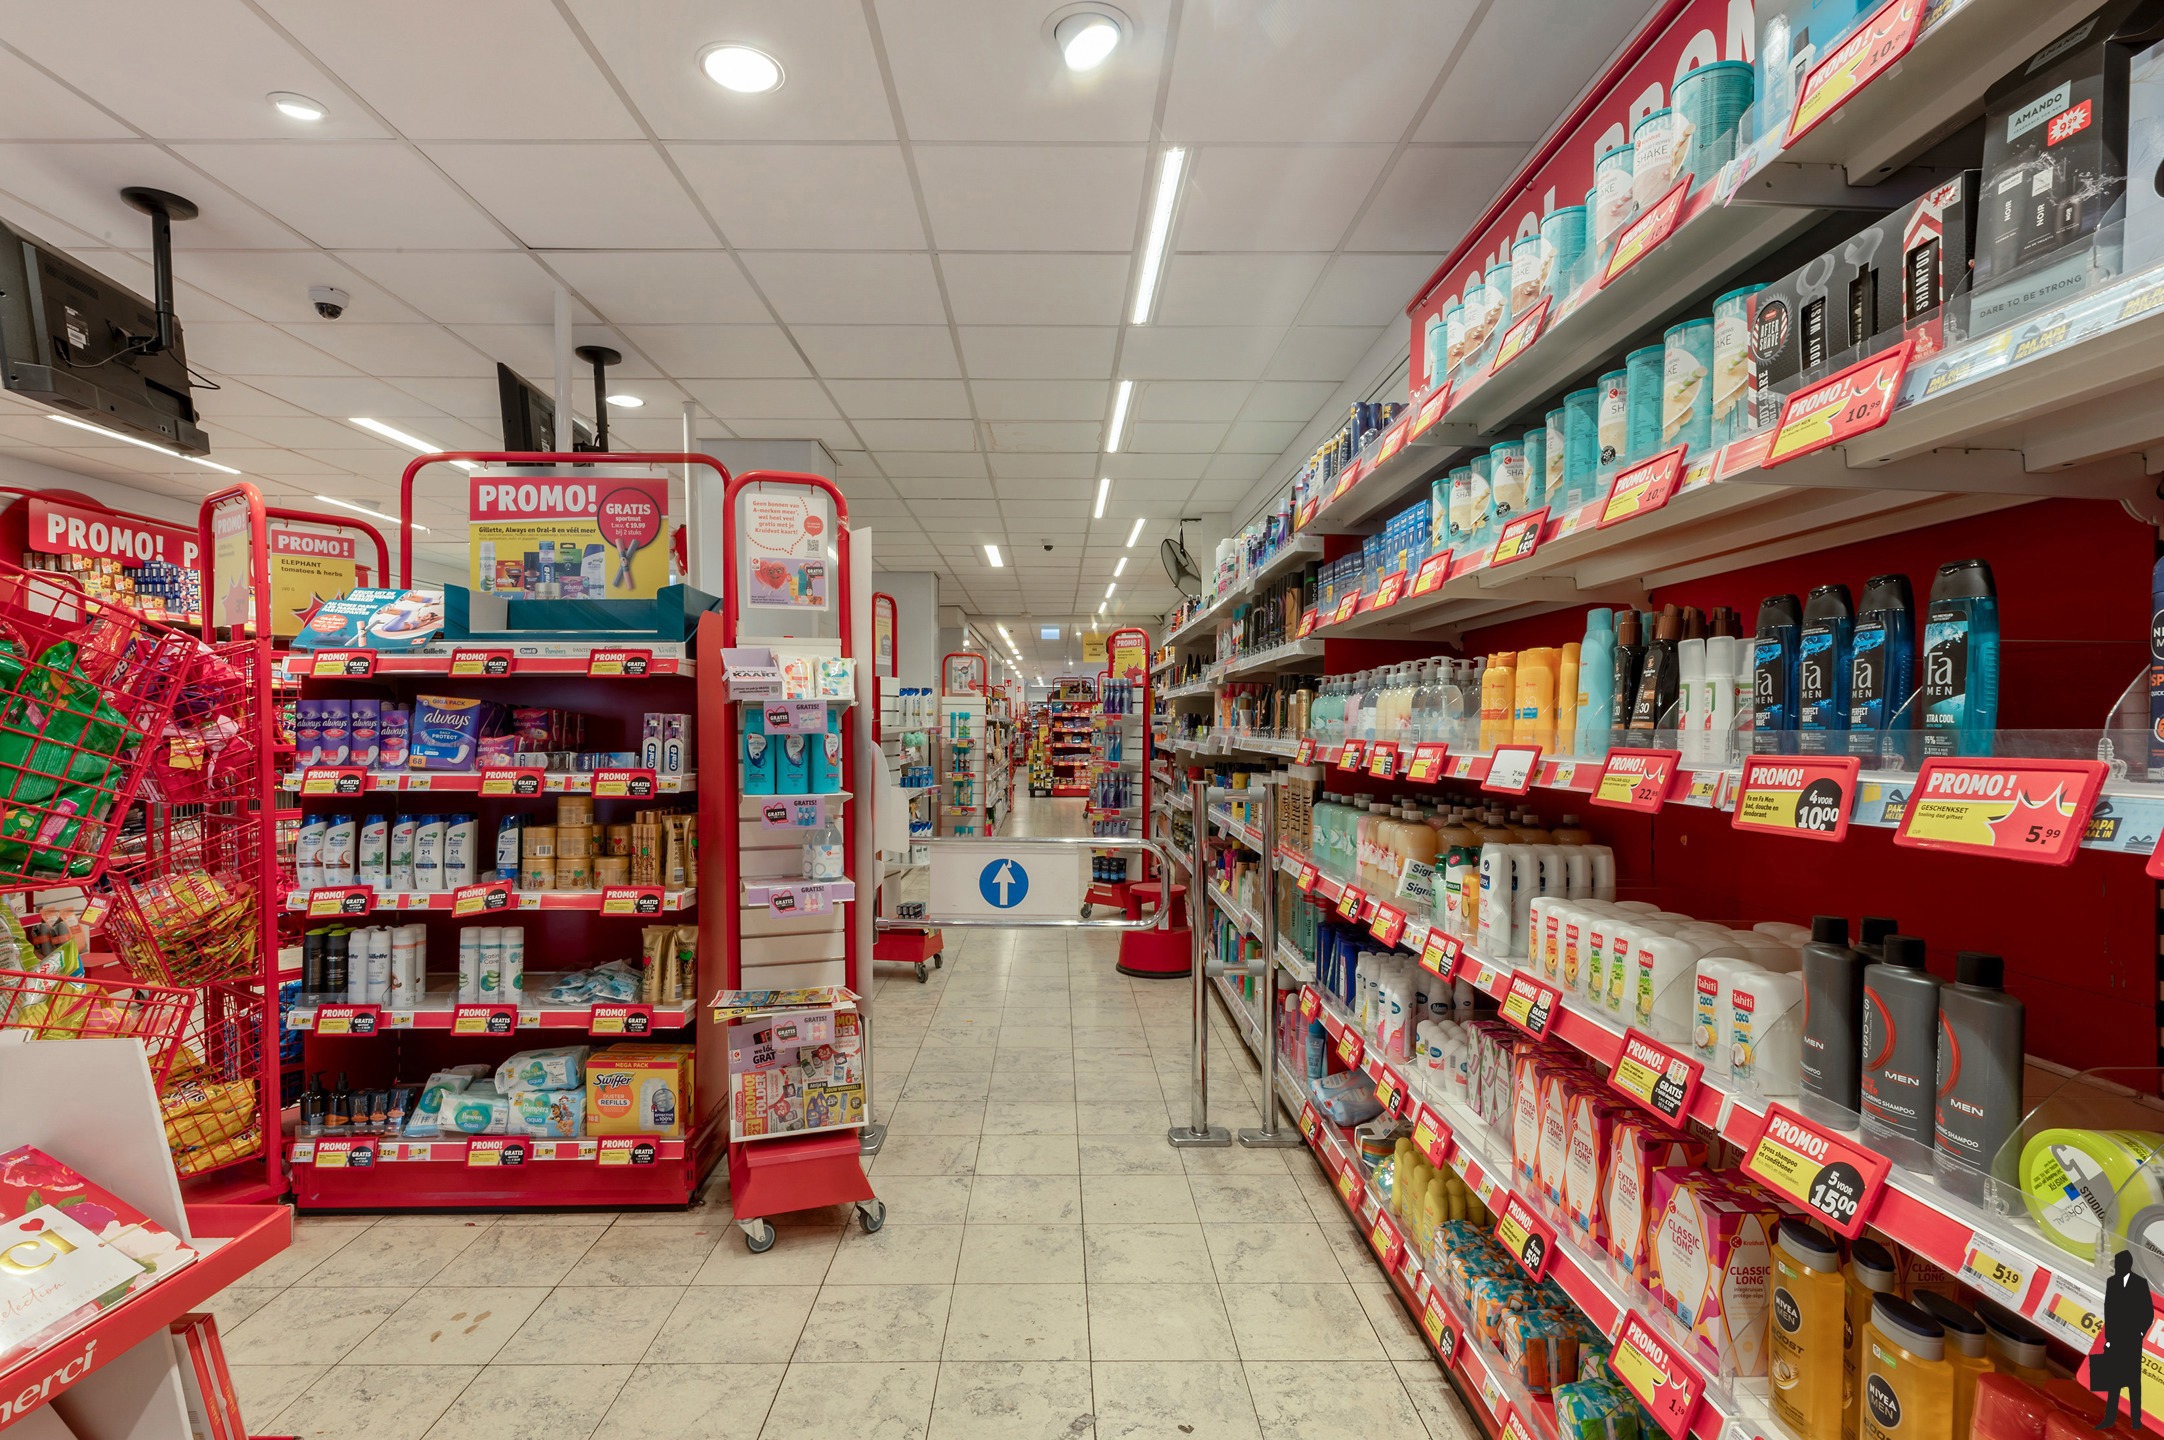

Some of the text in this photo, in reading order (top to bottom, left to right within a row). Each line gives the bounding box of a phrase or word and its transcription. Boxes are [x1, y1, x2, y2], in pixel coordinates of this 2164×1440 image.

[1805, 25, 1875, 96] PROMO!
[2014, 93, 2063, 126] AMANDO
[2004, 199, 2012, 222] NOIR
[2036, 203, 2045, 227] NOIR
[1916, 249, 1930, 312] SHAMPOO
[1980, 274, 2082, 318] DARE TO BE STRONG
[1760, 319, 1779, 338] AFTER
[2018, 325, 2067, 353] PAK PAPA
[1786, 378, 1851, 421] PROMO!
[1845, 400, 1881, 423] 10.99
[1615, 466, 1652, 494] PROMO!
[479, 484, 597, 513] PROMO!
[606, 504, 652, 515] GRATIS
[48, 513, 164, 562] PROMO!
[506, 527, 527, 535] Always
[277, 535, 349, 556] PROMO!
[281, 558, 322, 570] ELEPHANT
[281, 566, 343, 578] tomatoes herbs
[545, 648, 572, 656] Pampers
[1116, 639, 1141, 647] PROMO!
[318, 653, 349, 662] PROMO!
[456, 653, 487, 662] PROMO!
[595, 653, 627, 662] PROMO!
[1802, 661, 1822, 690] Fa
[1852, 658, 1873, 689] Fa
[1927, 652, 1953, 686] Fa
[1755, 669, 1773, 695] Fa
[1927, 686, 1953, 696] MEN
[1755, 696, 1774, 705] MEN
[1802, 690, 1822, 699] MEN
[1852, 689, 1873, 699] MEN
[423, 709, 471, 728] always
[1939, 714, 1955, 724] COOL
[412, 757, 423, 765] 68
[670, 744, 678, 771] Oral-B
[1608, 757, 1645, 772] PROMO!
[308, 770, 339, 780] PROMO!
[484, 770, 516, 780] PROMO!
[599, 772, 630, 781] PROMO!
[1749, 767, 1805, 788] PROMO!
[1927, 772, 2017, 797] PROMO!
[1747, 794, 1775, 805] Fa Men
[1755, 803, 1772, 811] douche
[1809, 790, 1834, 806] 4 VOOR
[767, 810, 786, 818] GRATIS
[1743, 809, 1768, 820] deodorant
[1921, 804, 1969, 815] GESCHENKSET
[1798, 806, 1839, 832] 10.00
[2025, 824, 2061, 847] 5.99
[313, 891, 345, 901] PROMO!
[457, 887, 487, 899] PROMO!
[488, 893, 506, 901] GRATIS
[606, 890, 638, 899] PROMO!
[484, 958, 500, 966] Care
[1639, 951, 1653, 967] tahiti
[1512, 980, 1537, 1000] PROMO!
[1698, 976, 1717, 994] tahiti
[1733, 991, 1754, 1010] tahiti
[322, 1008, 354, 1018] PROMO!
[459, 1008, 490, 1017] PROMO!
[595, 1008, 627, 1018] PROMO!
[804, 1016, 827, 1024] GRATIS!
[778, 1028, 796, 1036] GRATIS
[1804, 1035, 1824, 1050] MEN
[1628, 1040, 1664, 1070] PROMO!
[592, 1073, 632, 1089] Swiffer
[1885, 1070, 1920, 1086] MEN
[745, 1073, 756, 1119] PROMO!
[756, 1074, 767, 1118] FOLDER
[1659, 1080, 1682, 1099] GRATIS
[522, 1104, 549, 1114] Pampers
[1520, 1096, 1536, 1112] EXTRA
[1521, 1105, 1534, 1121] LONG
[1882, 1099, 1915, 1117] SHAMPOO
[1950, 1098, 1984, 1117] MEN
[1420, 1112, 1438, 1135] PROMO!
[1546, 1116, 1564, 1134] EXTRA
[1547, 1126, 1562, 1142] LONG
[1768, 1116, 1829, 1161] PROMO!
[1947, 1130, 1979, 1149] SHAMPOO
[319, 1142, 351, 1152] PROMO!
[471, 1140, 503, 1150] PROMO!
[601, 1139, 633, 1149] PROMO!
[1573, 1137, 1593, 1157] EXTRA
[1575, 1148, 1591, 1165] LONG
[1765, 1153, 1794, 1174] conditioner
[1774, 1149, 1798, 1168] shampoo
[1618, 1170, 1637, 1191] EXTRA
[1827, 1170, 1854, 1196] 5 VOOR
[1619, 1182, 1636, 1201] LONG
[1810, 1184, 1858, 1219] 15.00
[1508, 1201, 1534, 1232] PROMO!
[1668, 1219, 1700, 1250] CLASSIC
[1671, 1233, 1694, 1256] LONG
[1743, 1240, 1765, 1248] Kruidvat
[1729, 1266, 1771, 1276] CLASSIC
[1992, 1263, 2019, 1284] 5.19
[1735, 1276, 1764, 1285] LONG
[1775, 1296, 1798, 1319] NIVEA
[1776, 1308, 1796, 1327] MEN
[1628, 1322, 1669, 1370] PROMO!
[1869, 1383, 1897, 1412] NIVEA
[1870, 1398, 1893, 1420] MEN
